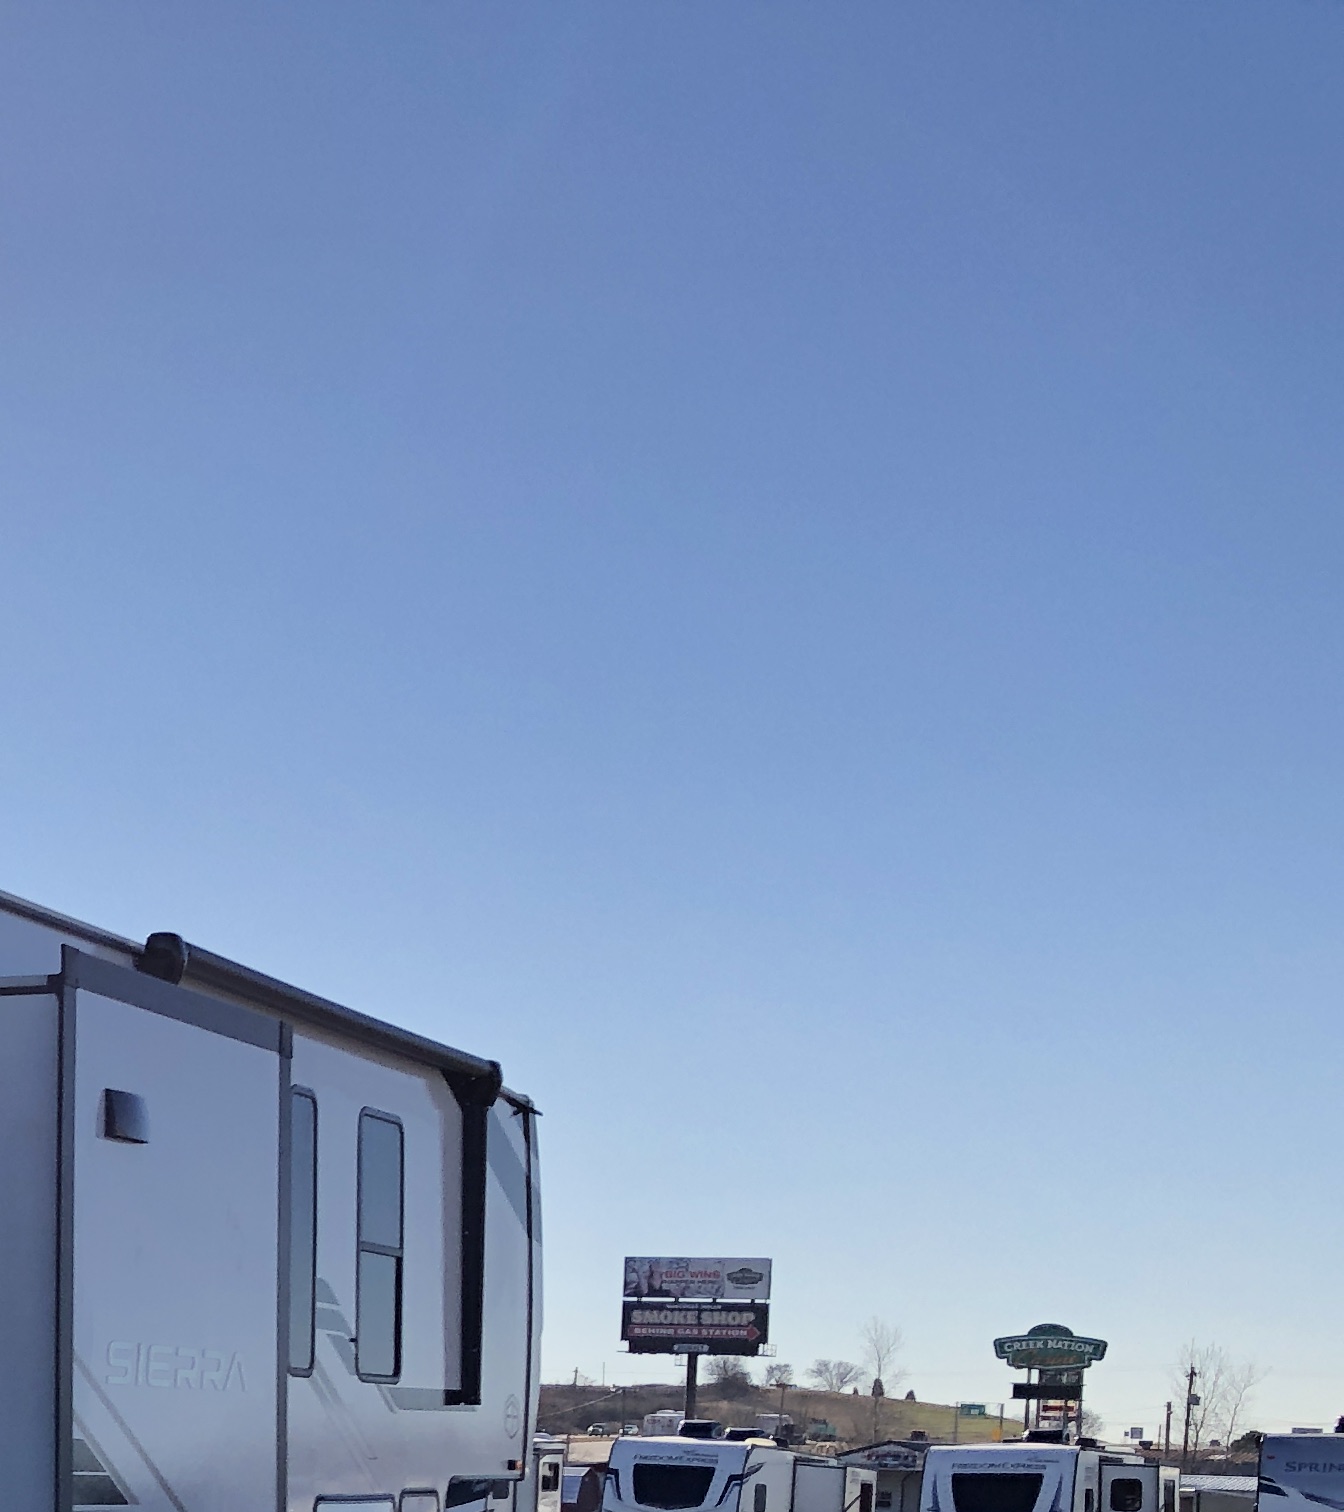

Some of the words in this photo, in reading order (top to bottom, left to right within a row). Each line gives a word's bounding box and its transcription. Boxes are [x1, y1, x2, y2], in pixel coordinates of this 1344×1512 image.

[664, 1269, 685, 1279] BIG
[630, 1309, 699, 1325] SMOKE
[700, 1310, 756, 1326] SHOP
[633, 1327, 675, 1336] BEHIND
[677, 1327, 699, 1336] GAS
[701, 1327, 748, 1337] STATION
[1004, 1340, 1044, 1352] CREEK
[1047, 1340, 1095, 1353] NATION
[105, 1338, 248, 1393] SIERRA
